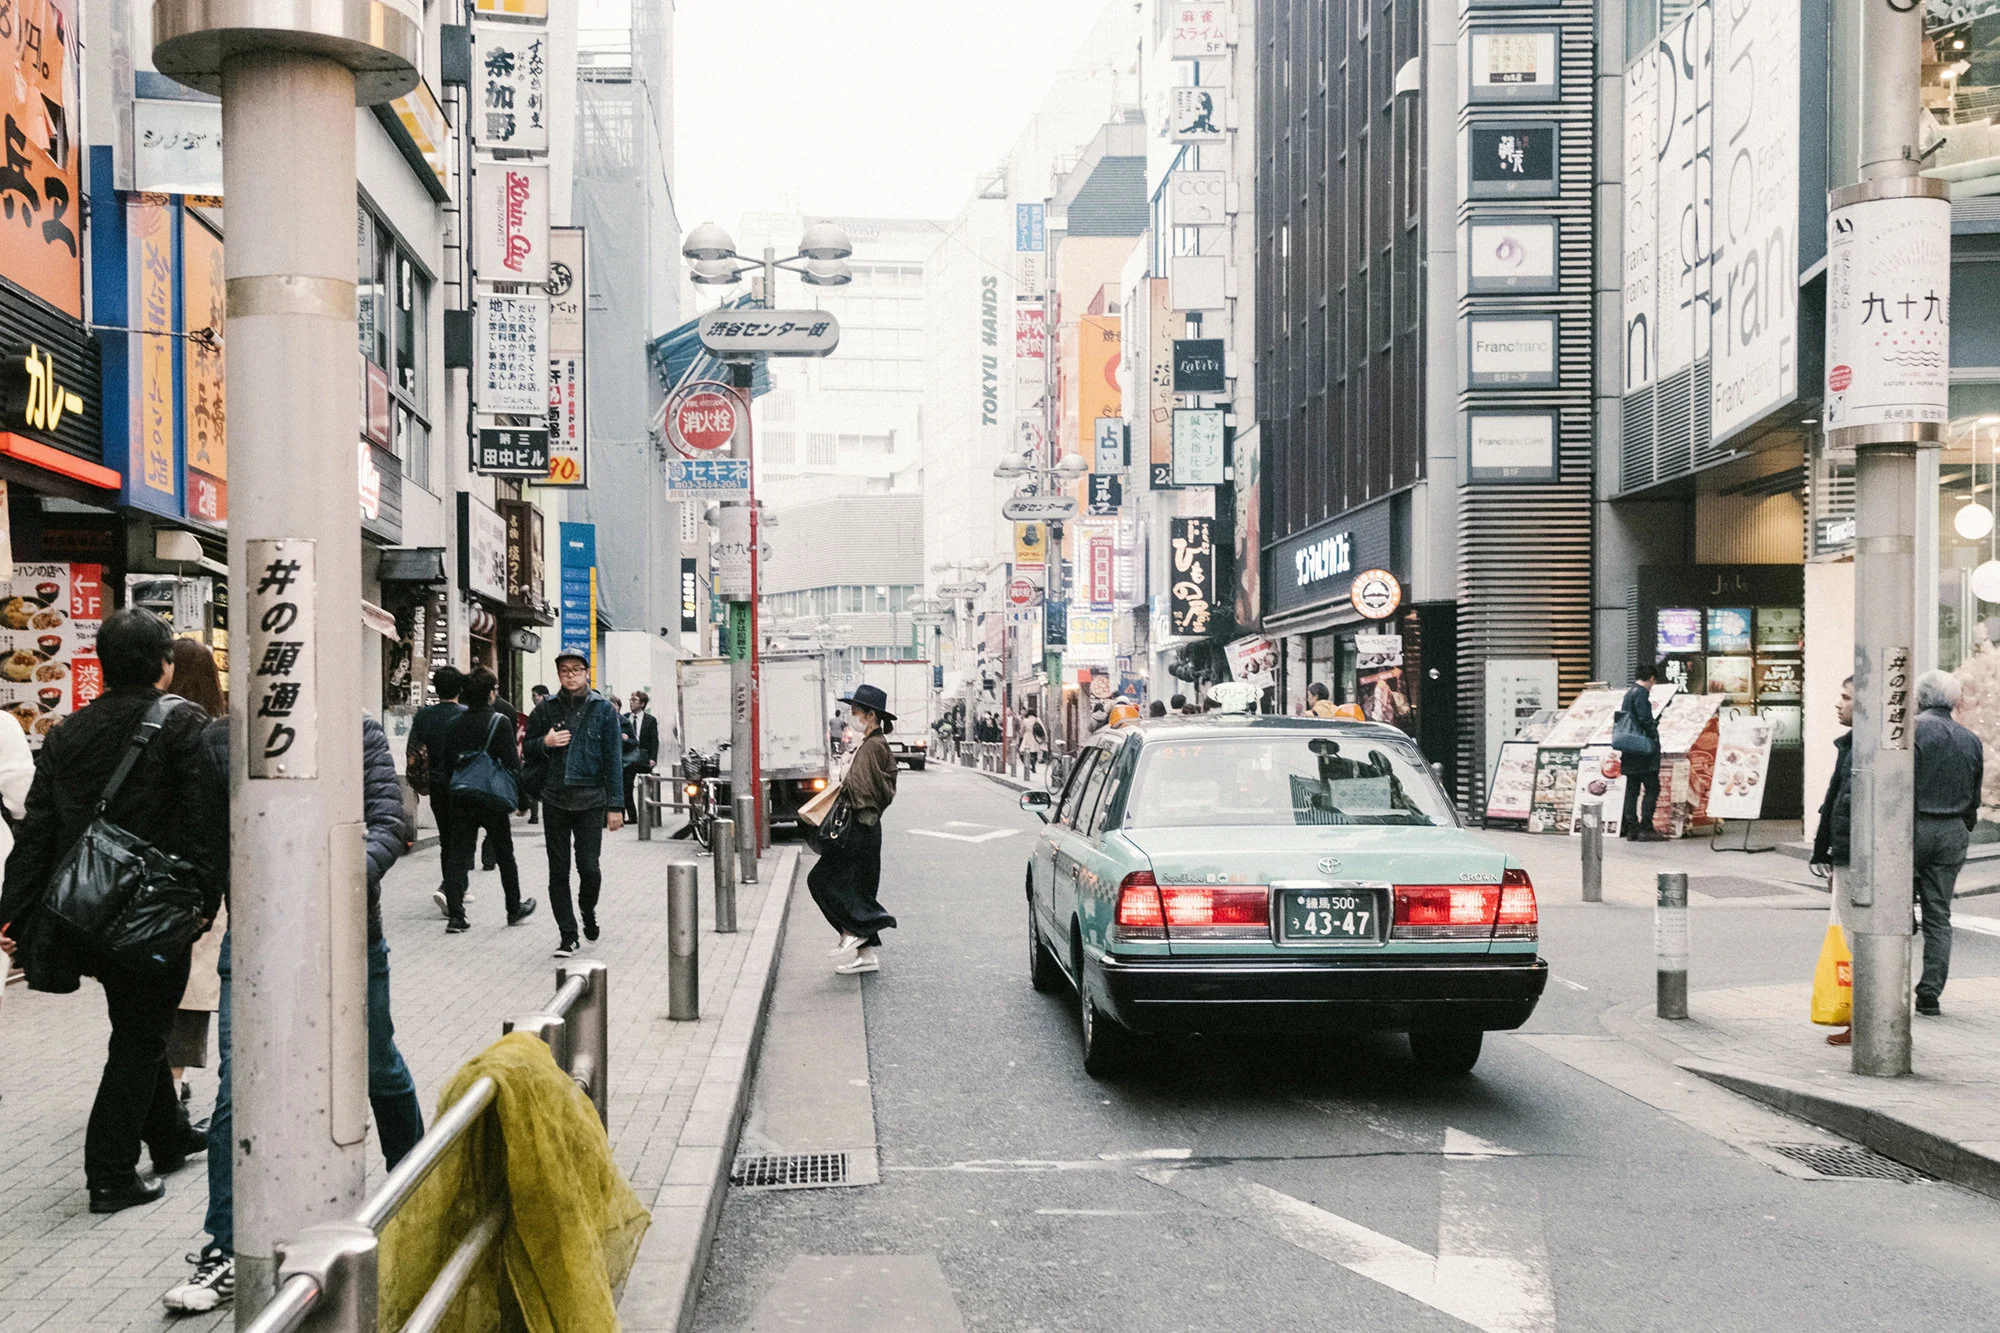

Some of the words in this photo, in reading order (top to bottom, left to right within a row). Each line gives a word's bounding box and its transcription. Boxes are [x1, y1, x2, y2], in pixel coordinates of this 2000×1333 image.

[1182, 11, 1213, 22] 麻雀
[1175, 27, 1223, 40] スライム
[1207, 42, 1221, 51] 5F
[982, 276, 997, 346] HANDS
[1862, 289, 1943, 326] 九十九
[706, 322, 830, 337] 渋谷センター街
[25, 343, 84, 431] カレー
[982, 354, 997, 426] TOKYU
[682, 409, 732, 434] 消火栓
[484, 449, 545, 467] 田中ビル
[71, 597, 101, 615] 3F
[256, 559, 304, 759] 井の頭通り
[1888, 655, 1908, 740] 井の頭通り
[1459, 872, 1498, 881] CROWN
[1306, 896, 1330, 909] 練馬
[1332, 896, 1354, 909] 500
[1304, 911, 1370, 935] 43-47
